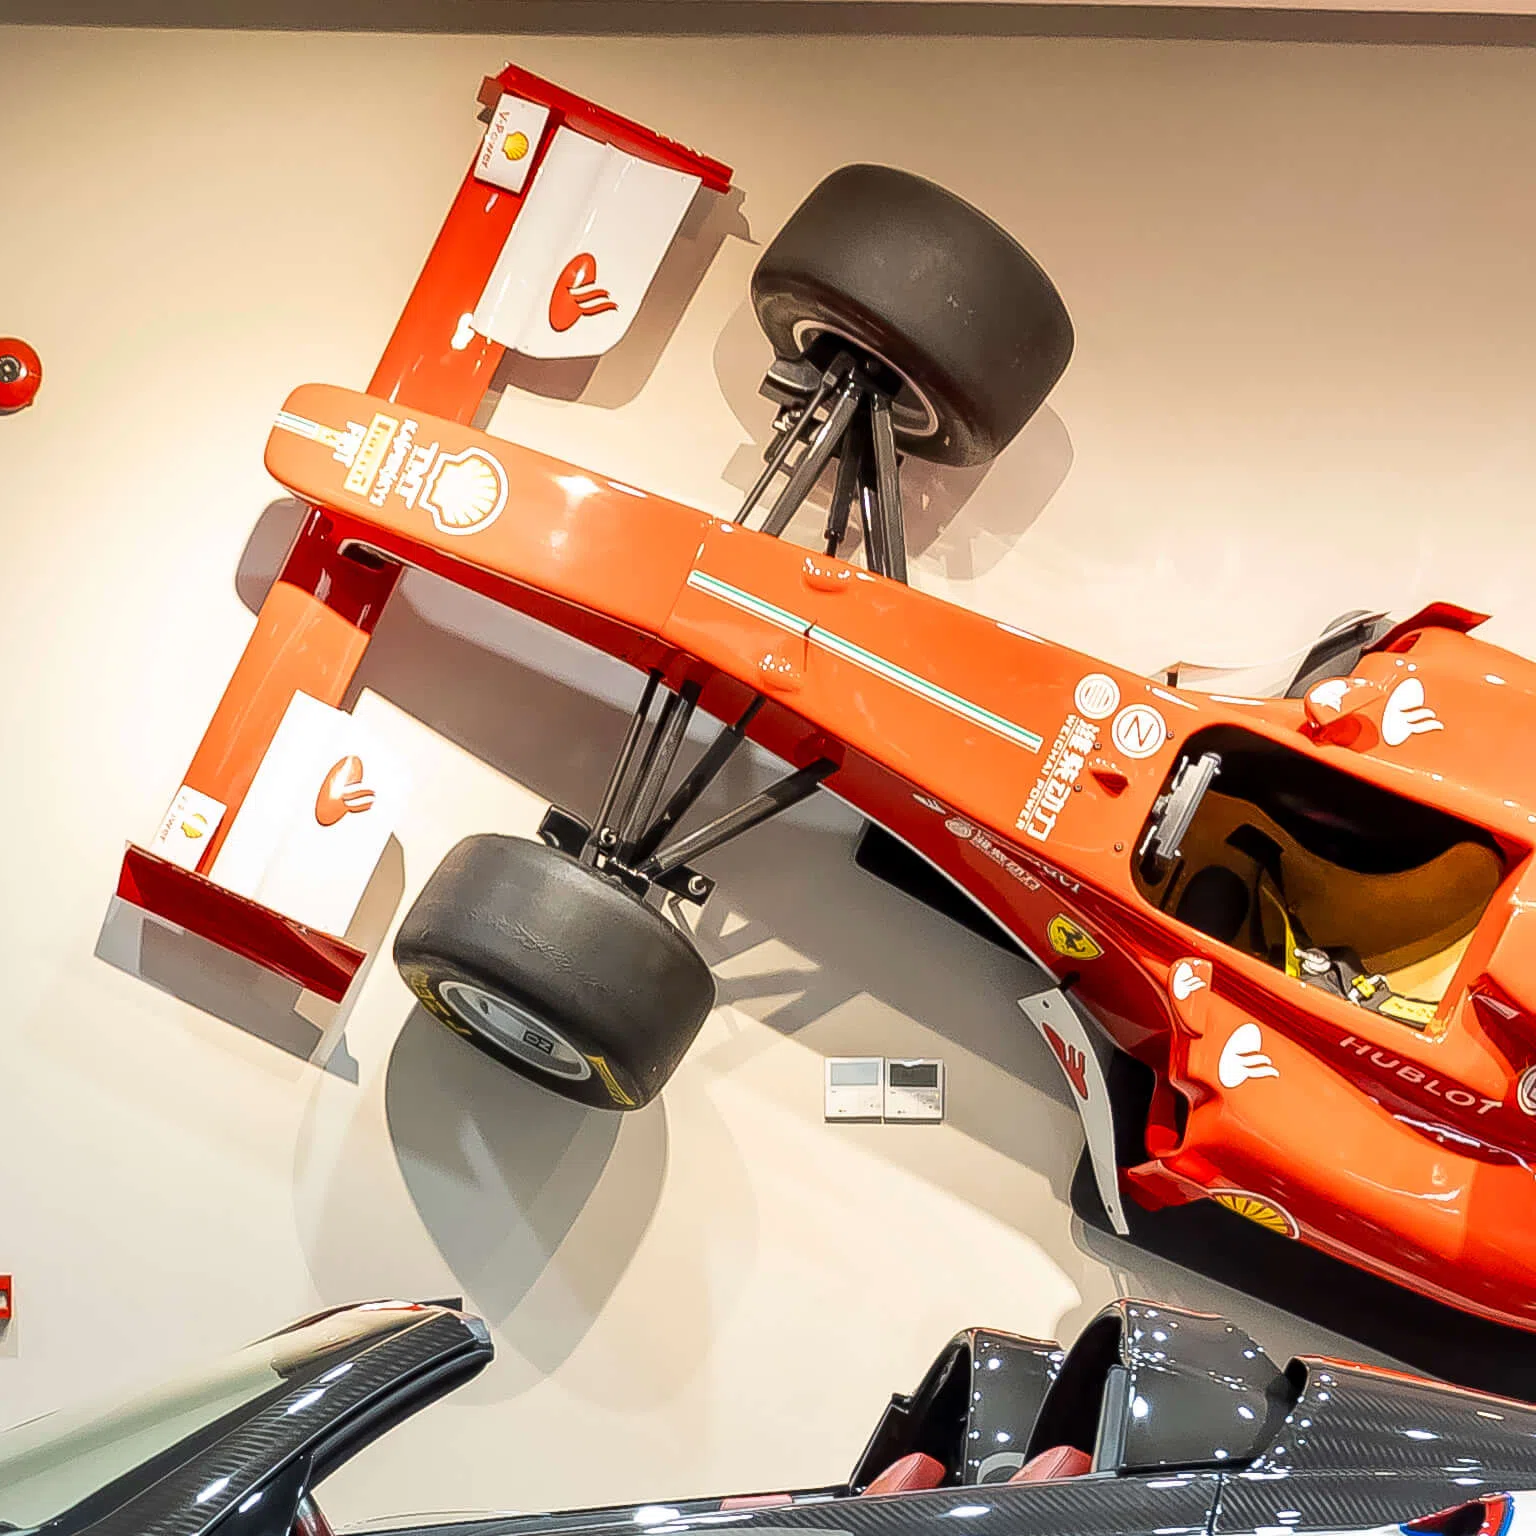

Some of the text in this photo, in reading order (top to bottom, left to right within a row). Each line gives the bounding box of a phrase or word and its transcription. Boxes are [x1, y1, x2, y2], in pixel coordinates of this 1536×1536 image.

[1015, 713, 1077, 830] WEICHAI POWER
[1339, 1034, 1503, 1115] HUBLOT
